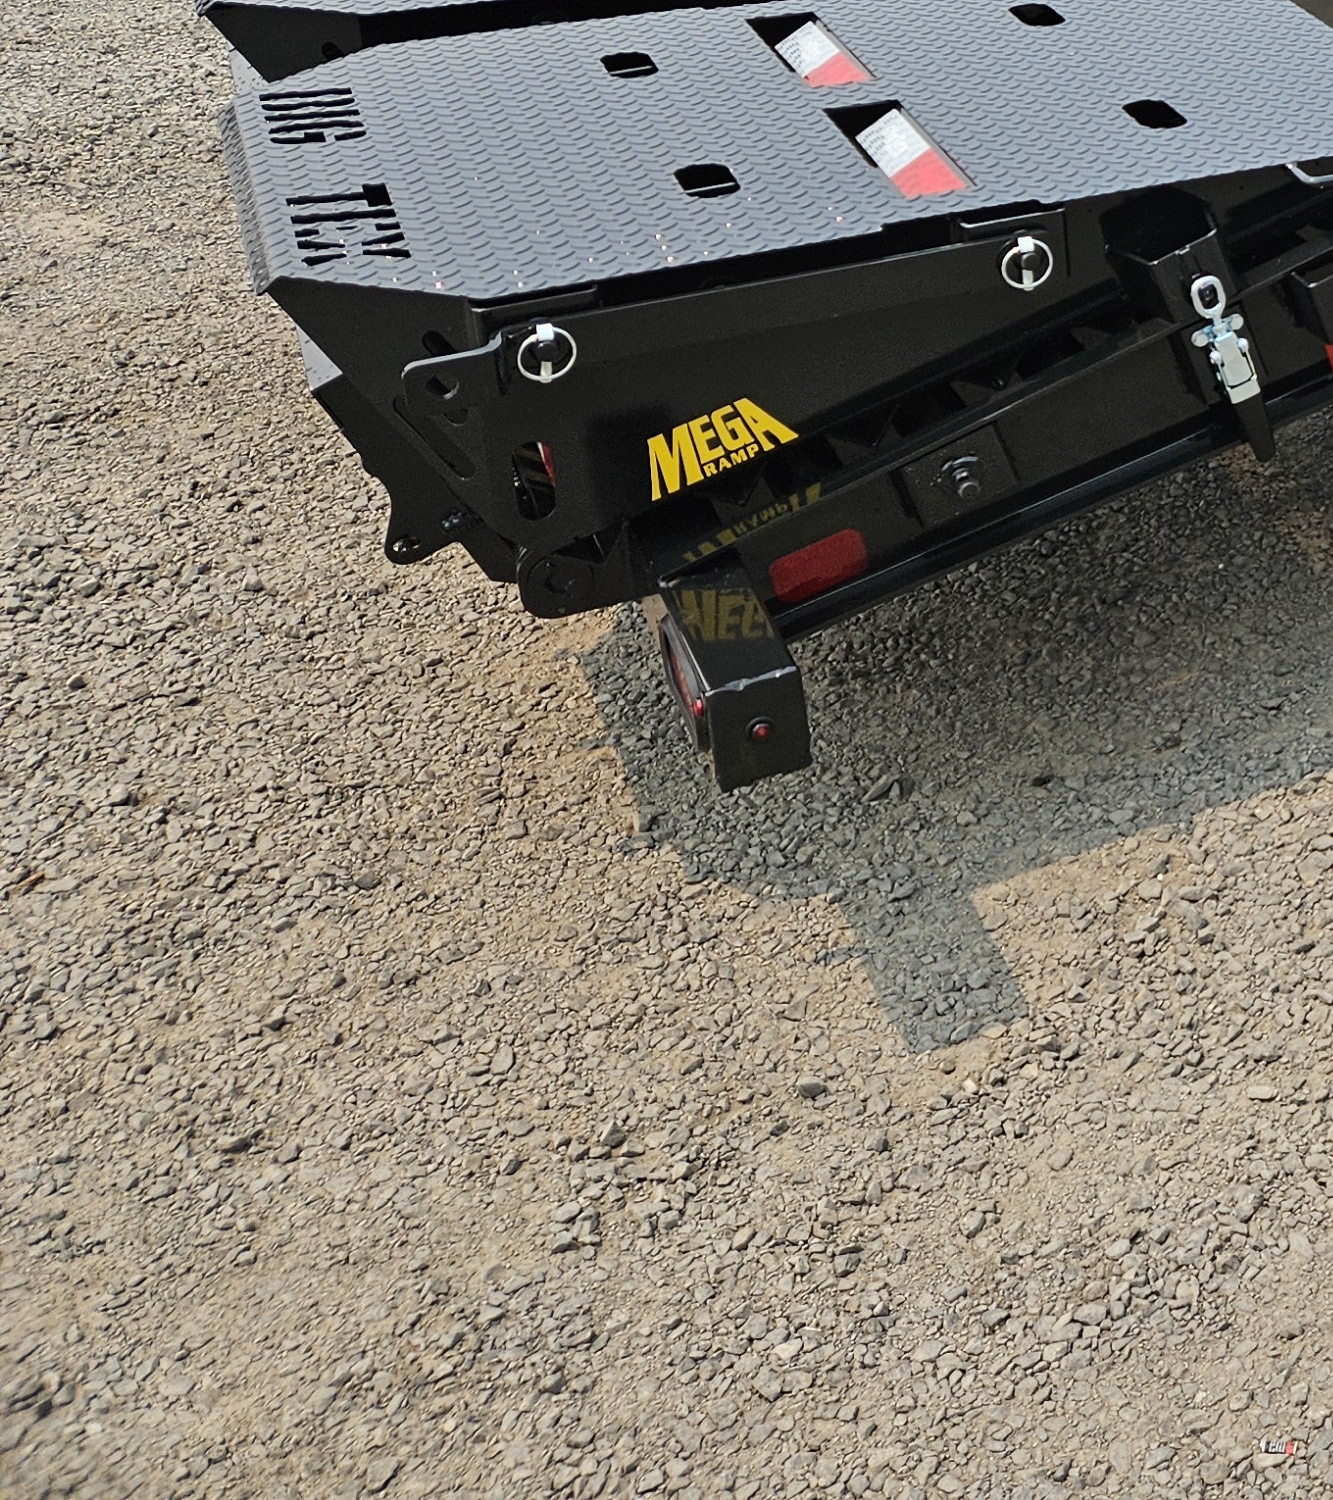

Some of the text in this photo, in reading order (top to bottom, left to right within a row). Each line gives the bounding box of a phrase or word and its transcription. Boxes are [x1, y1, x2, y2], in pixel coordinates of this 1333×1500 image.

[284, 181, 412, 267] TEX
[647, 397, 799, 502] MEGA
[702, 443, 760, 478] RAMP
